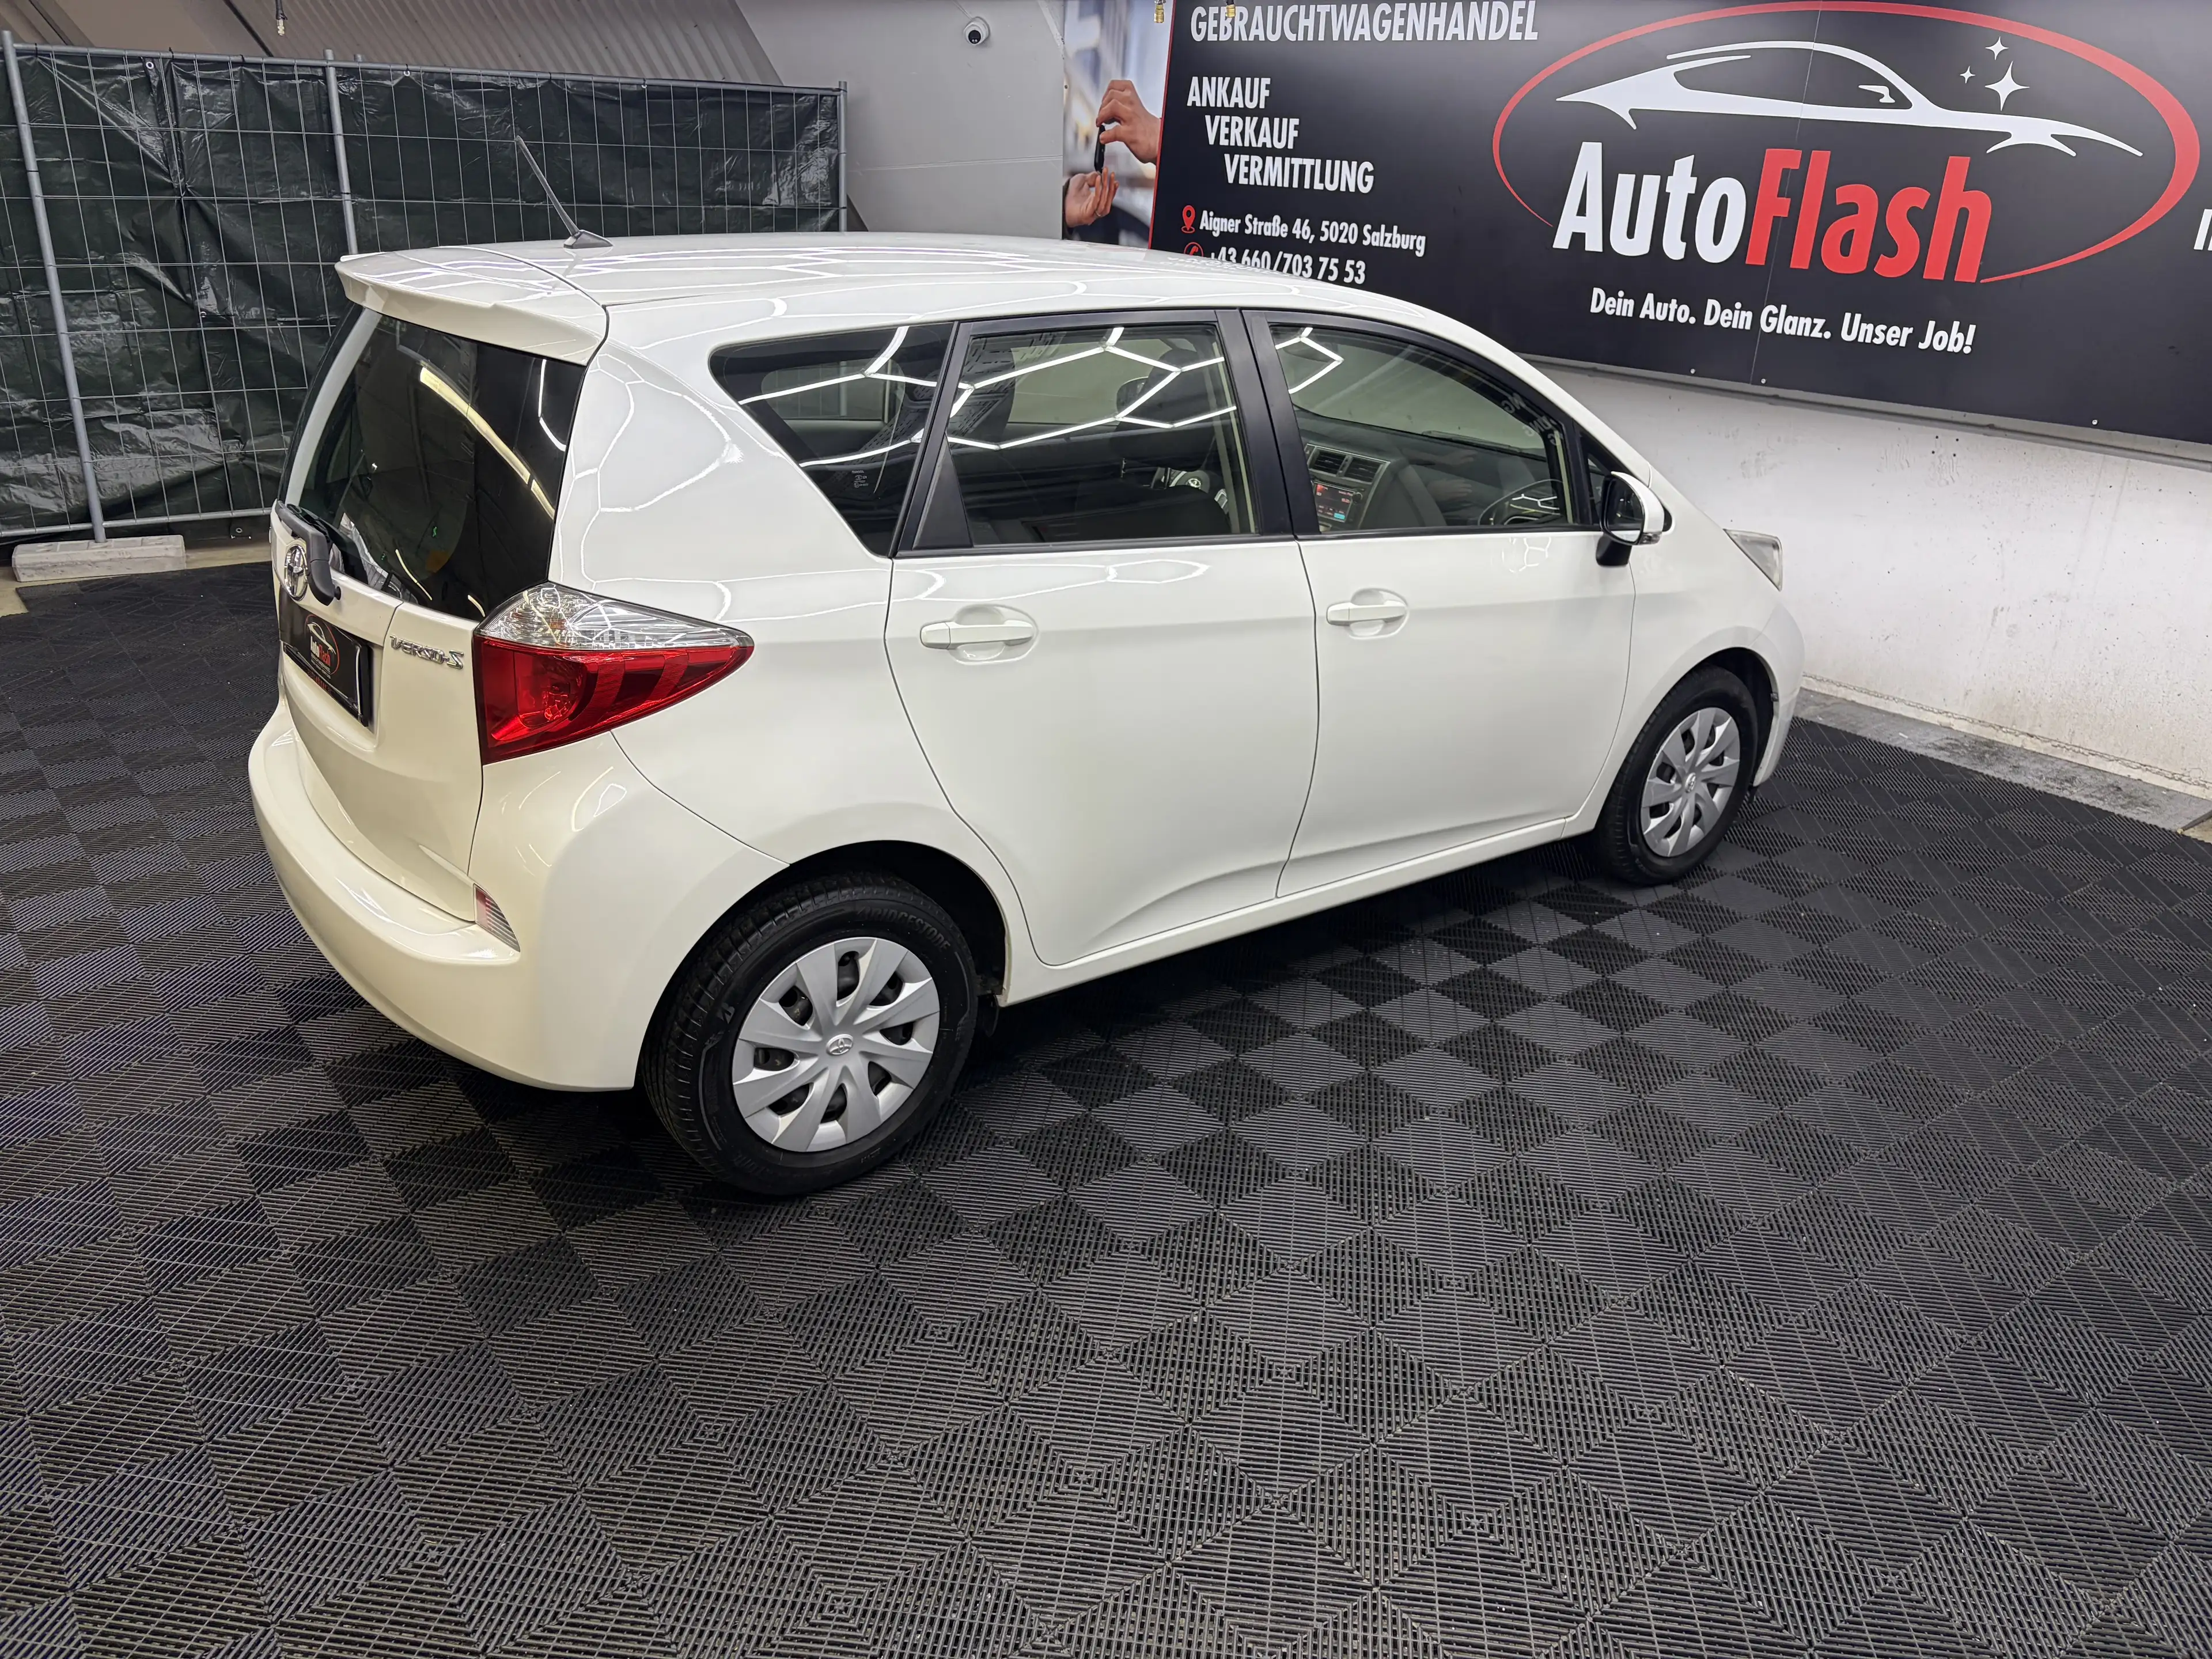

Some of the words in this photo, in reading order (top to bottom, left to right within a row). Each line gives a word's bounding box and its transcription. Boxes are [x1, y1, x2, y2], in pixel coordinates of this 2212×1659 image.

[1191, 1, 1538, 41] GEBRAUCHTWAGENHANDEL
[1187, 76, 1271, 109] ANKAUF
[1205, 115, 1300, 149] VERKAUF
[1224, 153, 1374, 194] VERMITTLUNG
[1552, 141, 1993, 283] AutoFlash
[1199, 210, 1241, 237] Aigner
[1245, 214, 1287, 237] Straße
[1292, 218, 1316, 243] 46,
[1320, 220, 1358, 244] 5020
[1362, 225, 1426, 257] Salzburg
[1317, 256, 1339, 281] 75
[1343, 259, 1366, 285] 53
[1590, 287, 1634, 317] Dein
[1639, 293, 1696, 324] Auto.
[1704, 298, 1752, 330] Dein
[1760, 304, 1831, 339] Glanz.
[1840, 312, 1913, 347] Unser
[1918, 320, 1976, 354] Job!
[389, 635, 464, 669] VERSO-S
